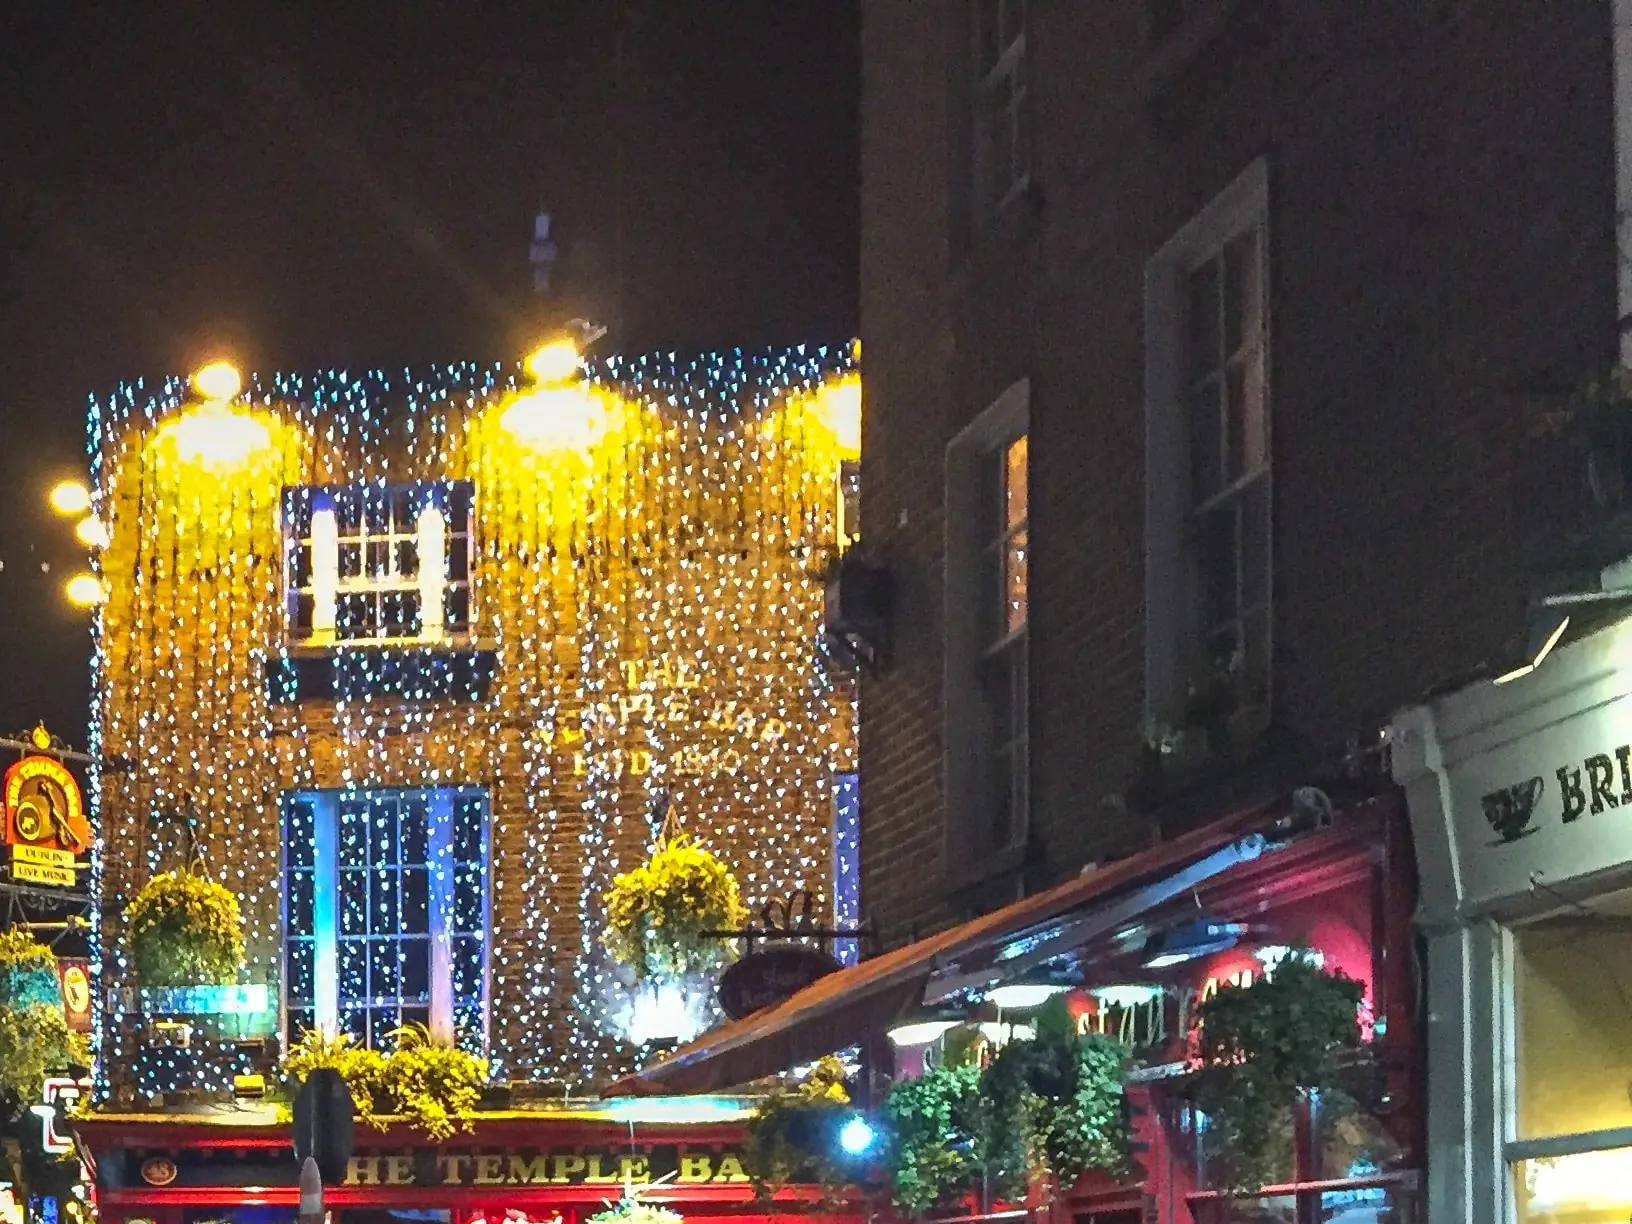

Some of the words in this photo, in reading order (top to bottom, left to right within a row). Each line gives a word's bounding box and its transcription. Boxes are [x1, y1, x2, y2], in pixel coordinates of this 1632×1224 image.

[342, 1155, 415, 1185] HE
[437, 1154, 651, 1184] TEMPLE
[676, 1153, 751, 1183] BA
